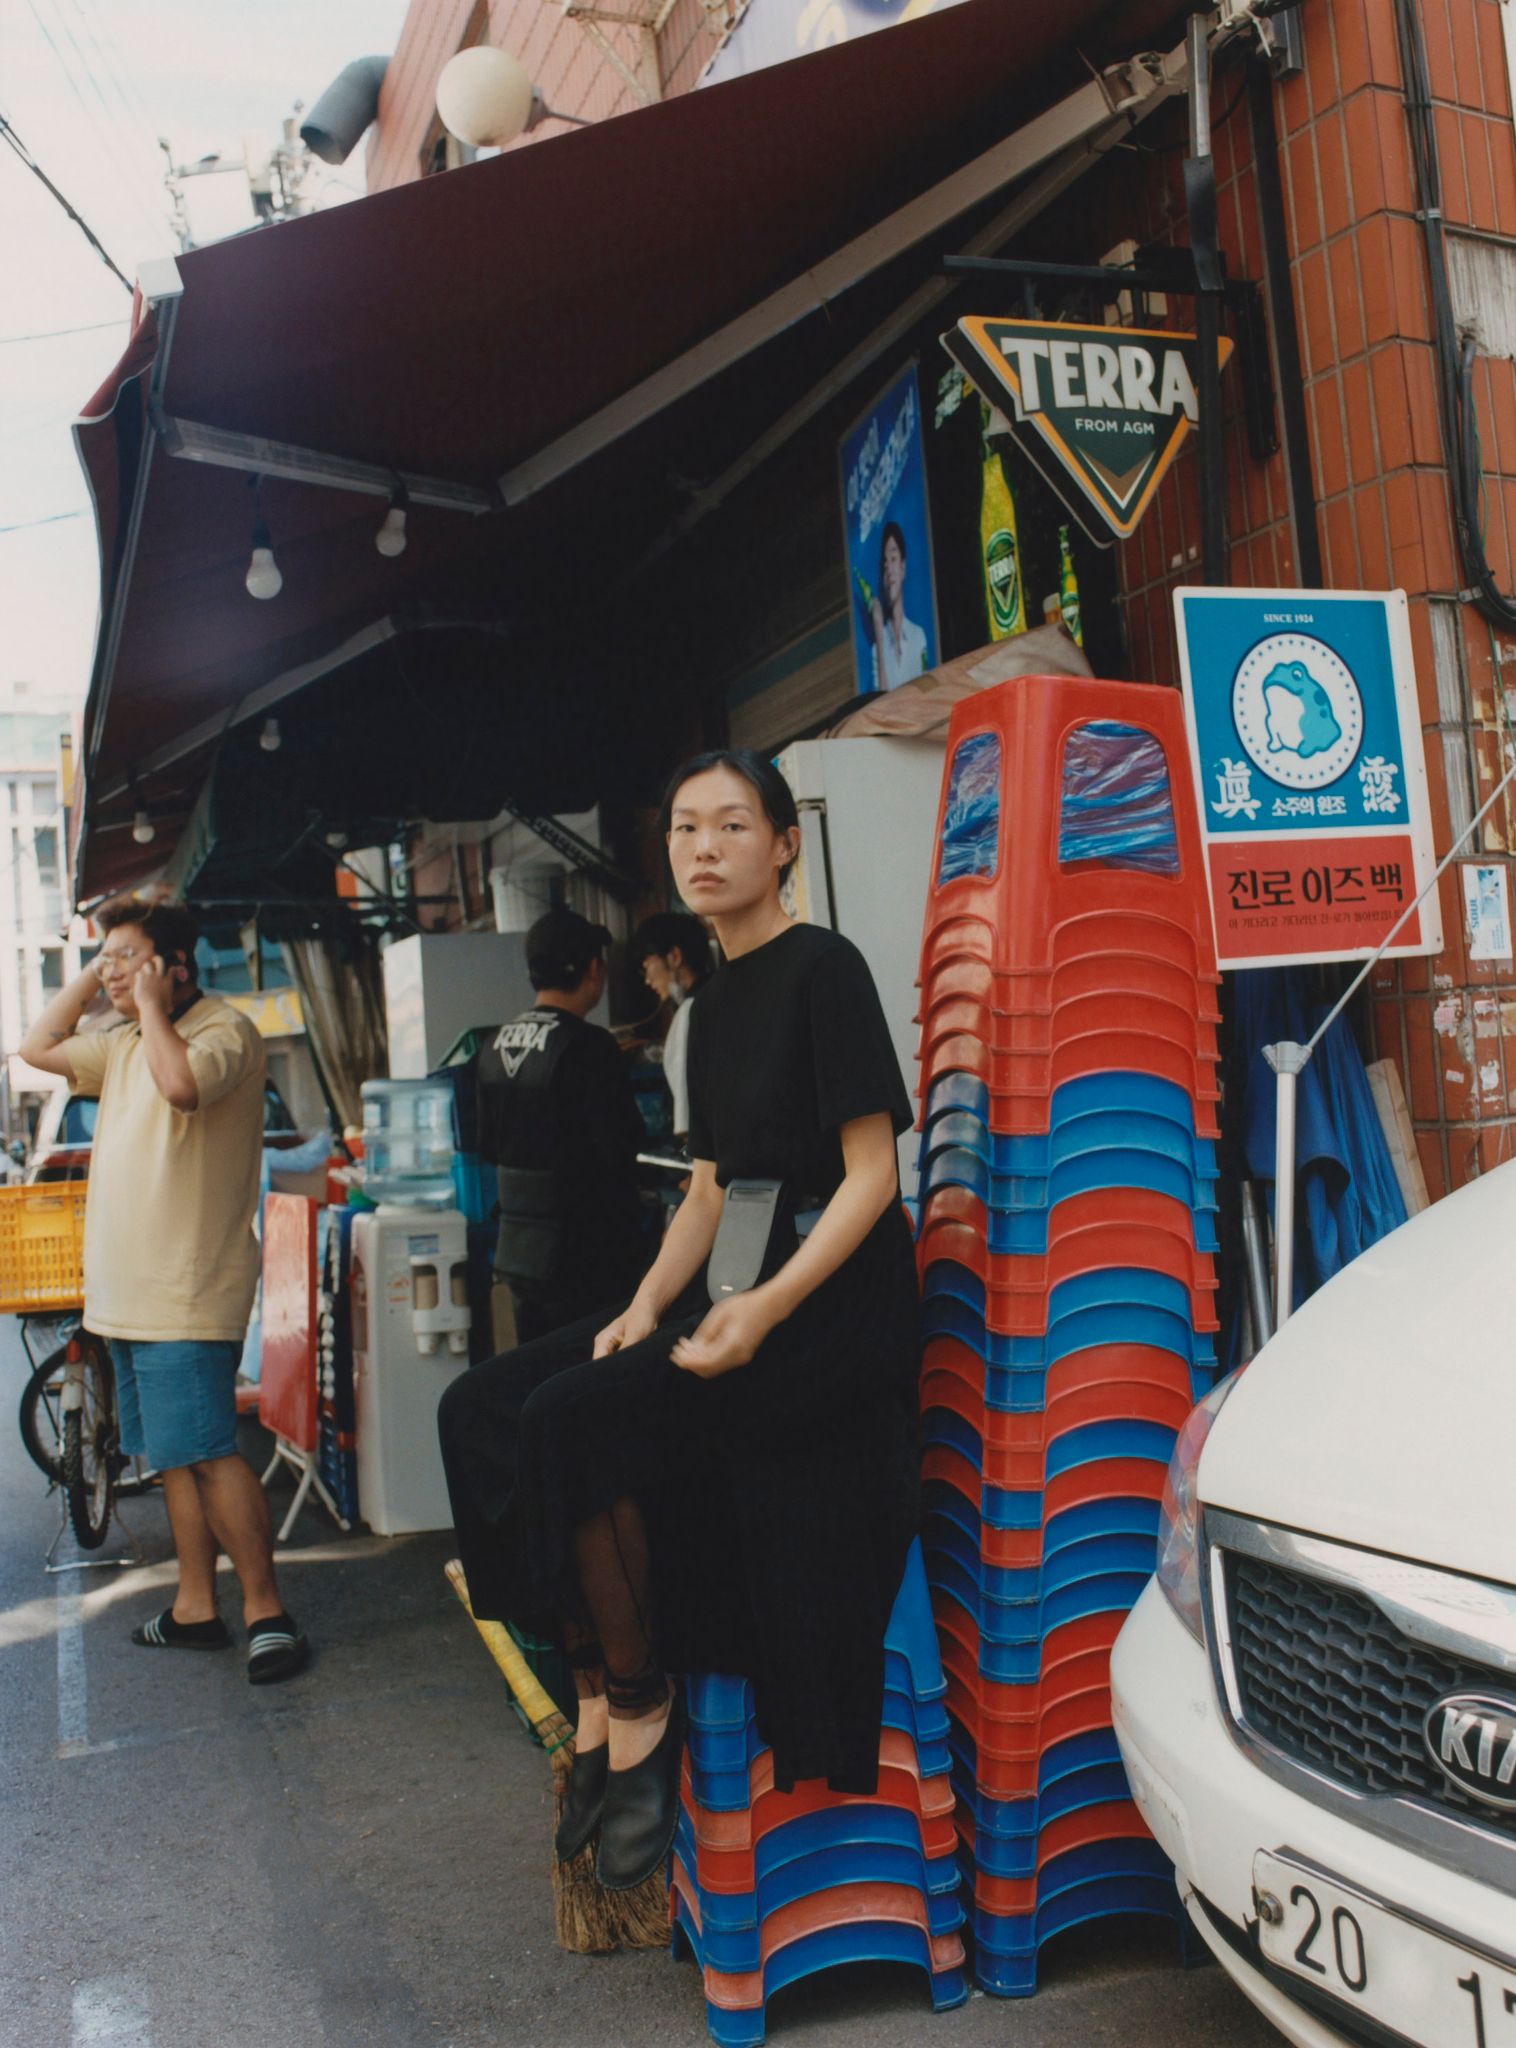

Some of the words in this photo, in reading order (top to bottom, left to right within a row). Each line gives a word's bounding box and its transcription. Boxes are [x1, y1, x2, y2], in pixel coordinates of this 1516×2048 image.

[1000, 337, 1199, 421] TERRA
[1075, 418, 1118, 432] FROM
[1123, 421, 1155, 435] AGM
[1263, 613, 1293, 623] SINCE
[1295, 614, 1314, 623] 1924
[1272, 796, 1315, 816] 소주의
[1317, 795, 1347, 815] 원조
[1227, 870, 1295, 910] 진로
[1302, 866, 1366, 906] 이즈
[1369, 863, 1404, 902] 백
[1290, 1884, 1367, 1993] 20
